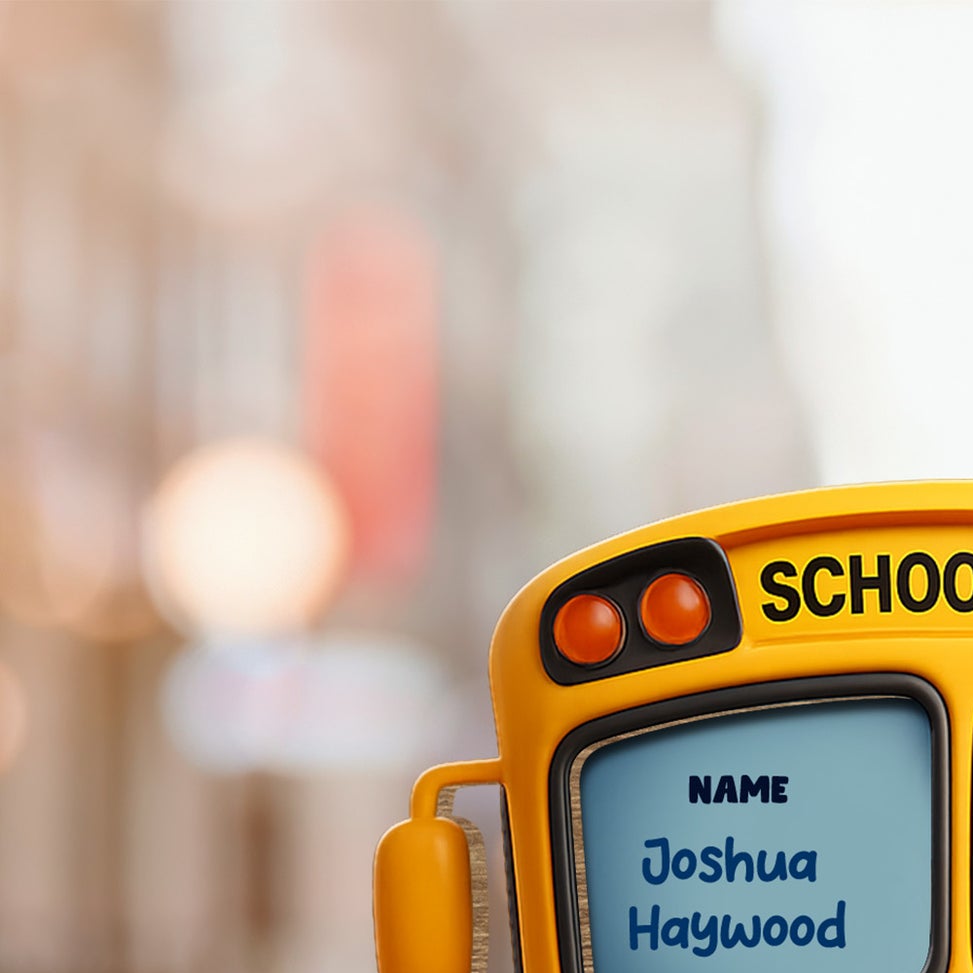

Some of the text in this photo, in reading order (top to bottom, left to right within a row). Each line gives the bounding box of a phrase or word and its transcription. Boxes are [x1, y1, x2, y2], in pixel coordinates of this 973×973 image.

[688, 774, 789, 805] NAME
[641, 836, 818, 886] Joshua
[628, 900, 847, 958] Haywood
